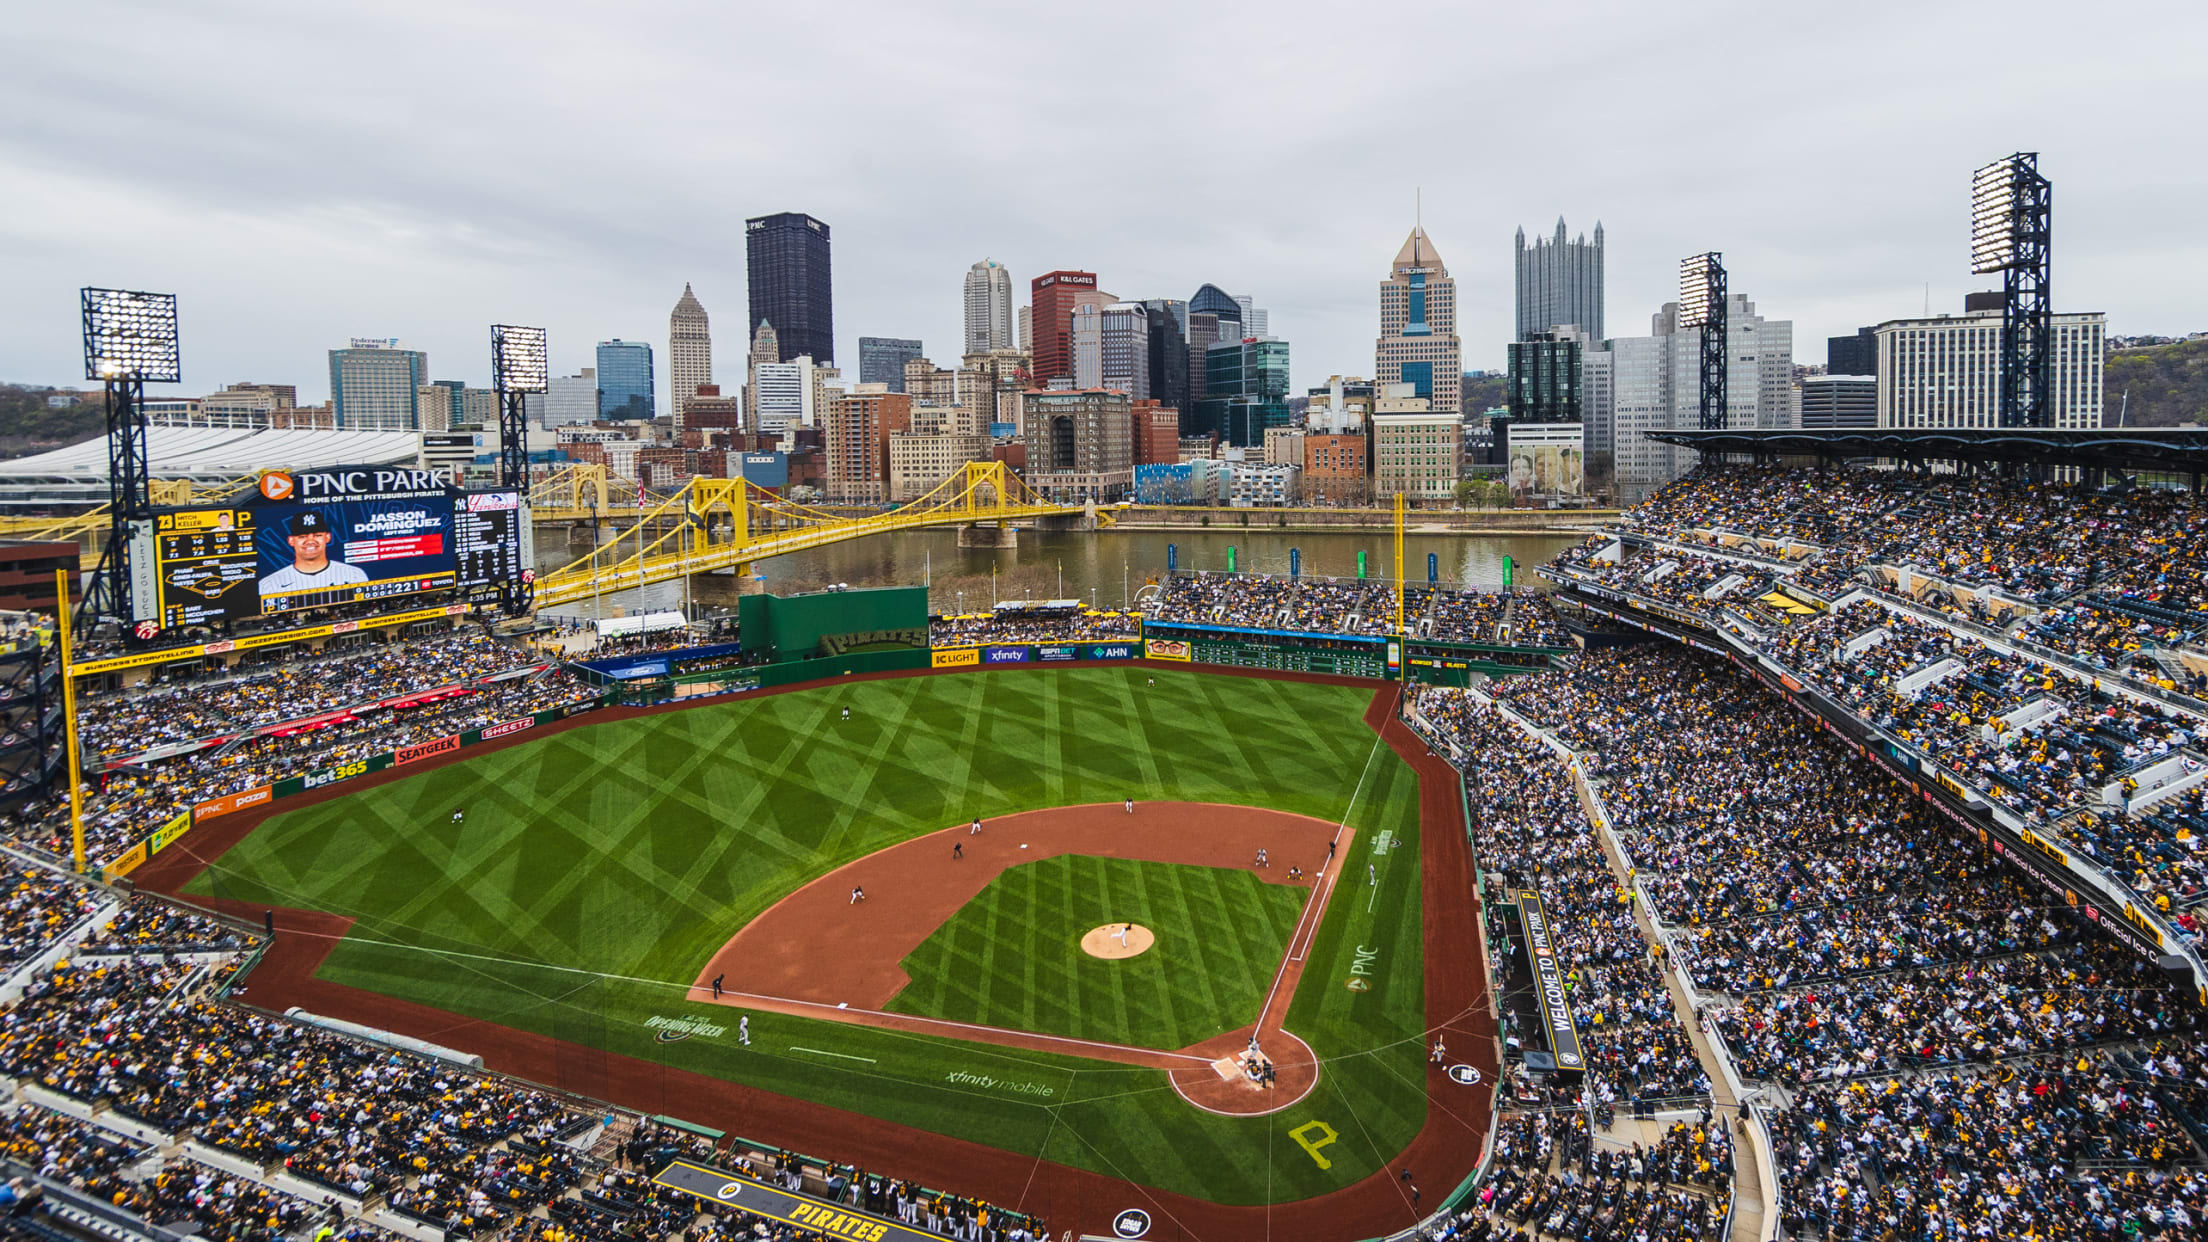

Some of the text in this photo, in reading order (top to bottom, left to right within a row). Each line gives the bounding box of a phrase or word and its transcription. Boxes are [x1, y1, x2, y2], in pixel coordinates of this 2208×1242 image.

[1073, 276, 1093, 284] GATES
[299, 469, 446, 496] PNC PARK
[303, 490, 446, 504] HOME OF THE PITTSBURGH PIRATES
[468, 493, 518, 512] Yankees
[237, 511, 251, 528] P
[370, 510, 426, 523] JASSON
[485, 591, 498, 600] PM
[365, 617, 397, 626] BUSINESS
[828, 628, 928, 653] PIRATES
[948, 653, 975, 663] LIGHT
[991, 650, 1023, 662] xfinity
[1061, 647, 1076, 655] BET
[1105, 648, 1127, 658] AHN
[84, 650, 195, 671] BUSINESS STORYTELLING
[485, 719, 532, 737] SHEETZ
[398, 738, 458, 763] SEATGEEK
[1896, 751, 1909, 766] AHN
[304, 760, 367, 788] bet365
[235, 791, 268, 807] paze
[201, 803, 224, 815] PNC
[1932, 796, 1978, 835] Official Ice Cream
[2004, 848, 2029, 871] Official
[2028, 864, 2040, 879] Ice
[2040, 873, 2064, 897] Cream
[2100, 915, 2132, 945] Official
[2132, 938, 2147, 956] Ice
[1351, 944, 1378, 975] PNC
[1527, 911, 1571, 1032] WELCOME TO PNC PARK
[644, 1015, 728, 1038] OPENING WEEK
[945, 1070, 1054, 1097] xfinity mobile
[1288, 1120, 1339, 1170] P
[722, 1186, 736, 1195] P
[788, 1203, 888, 1242] PIRATES
